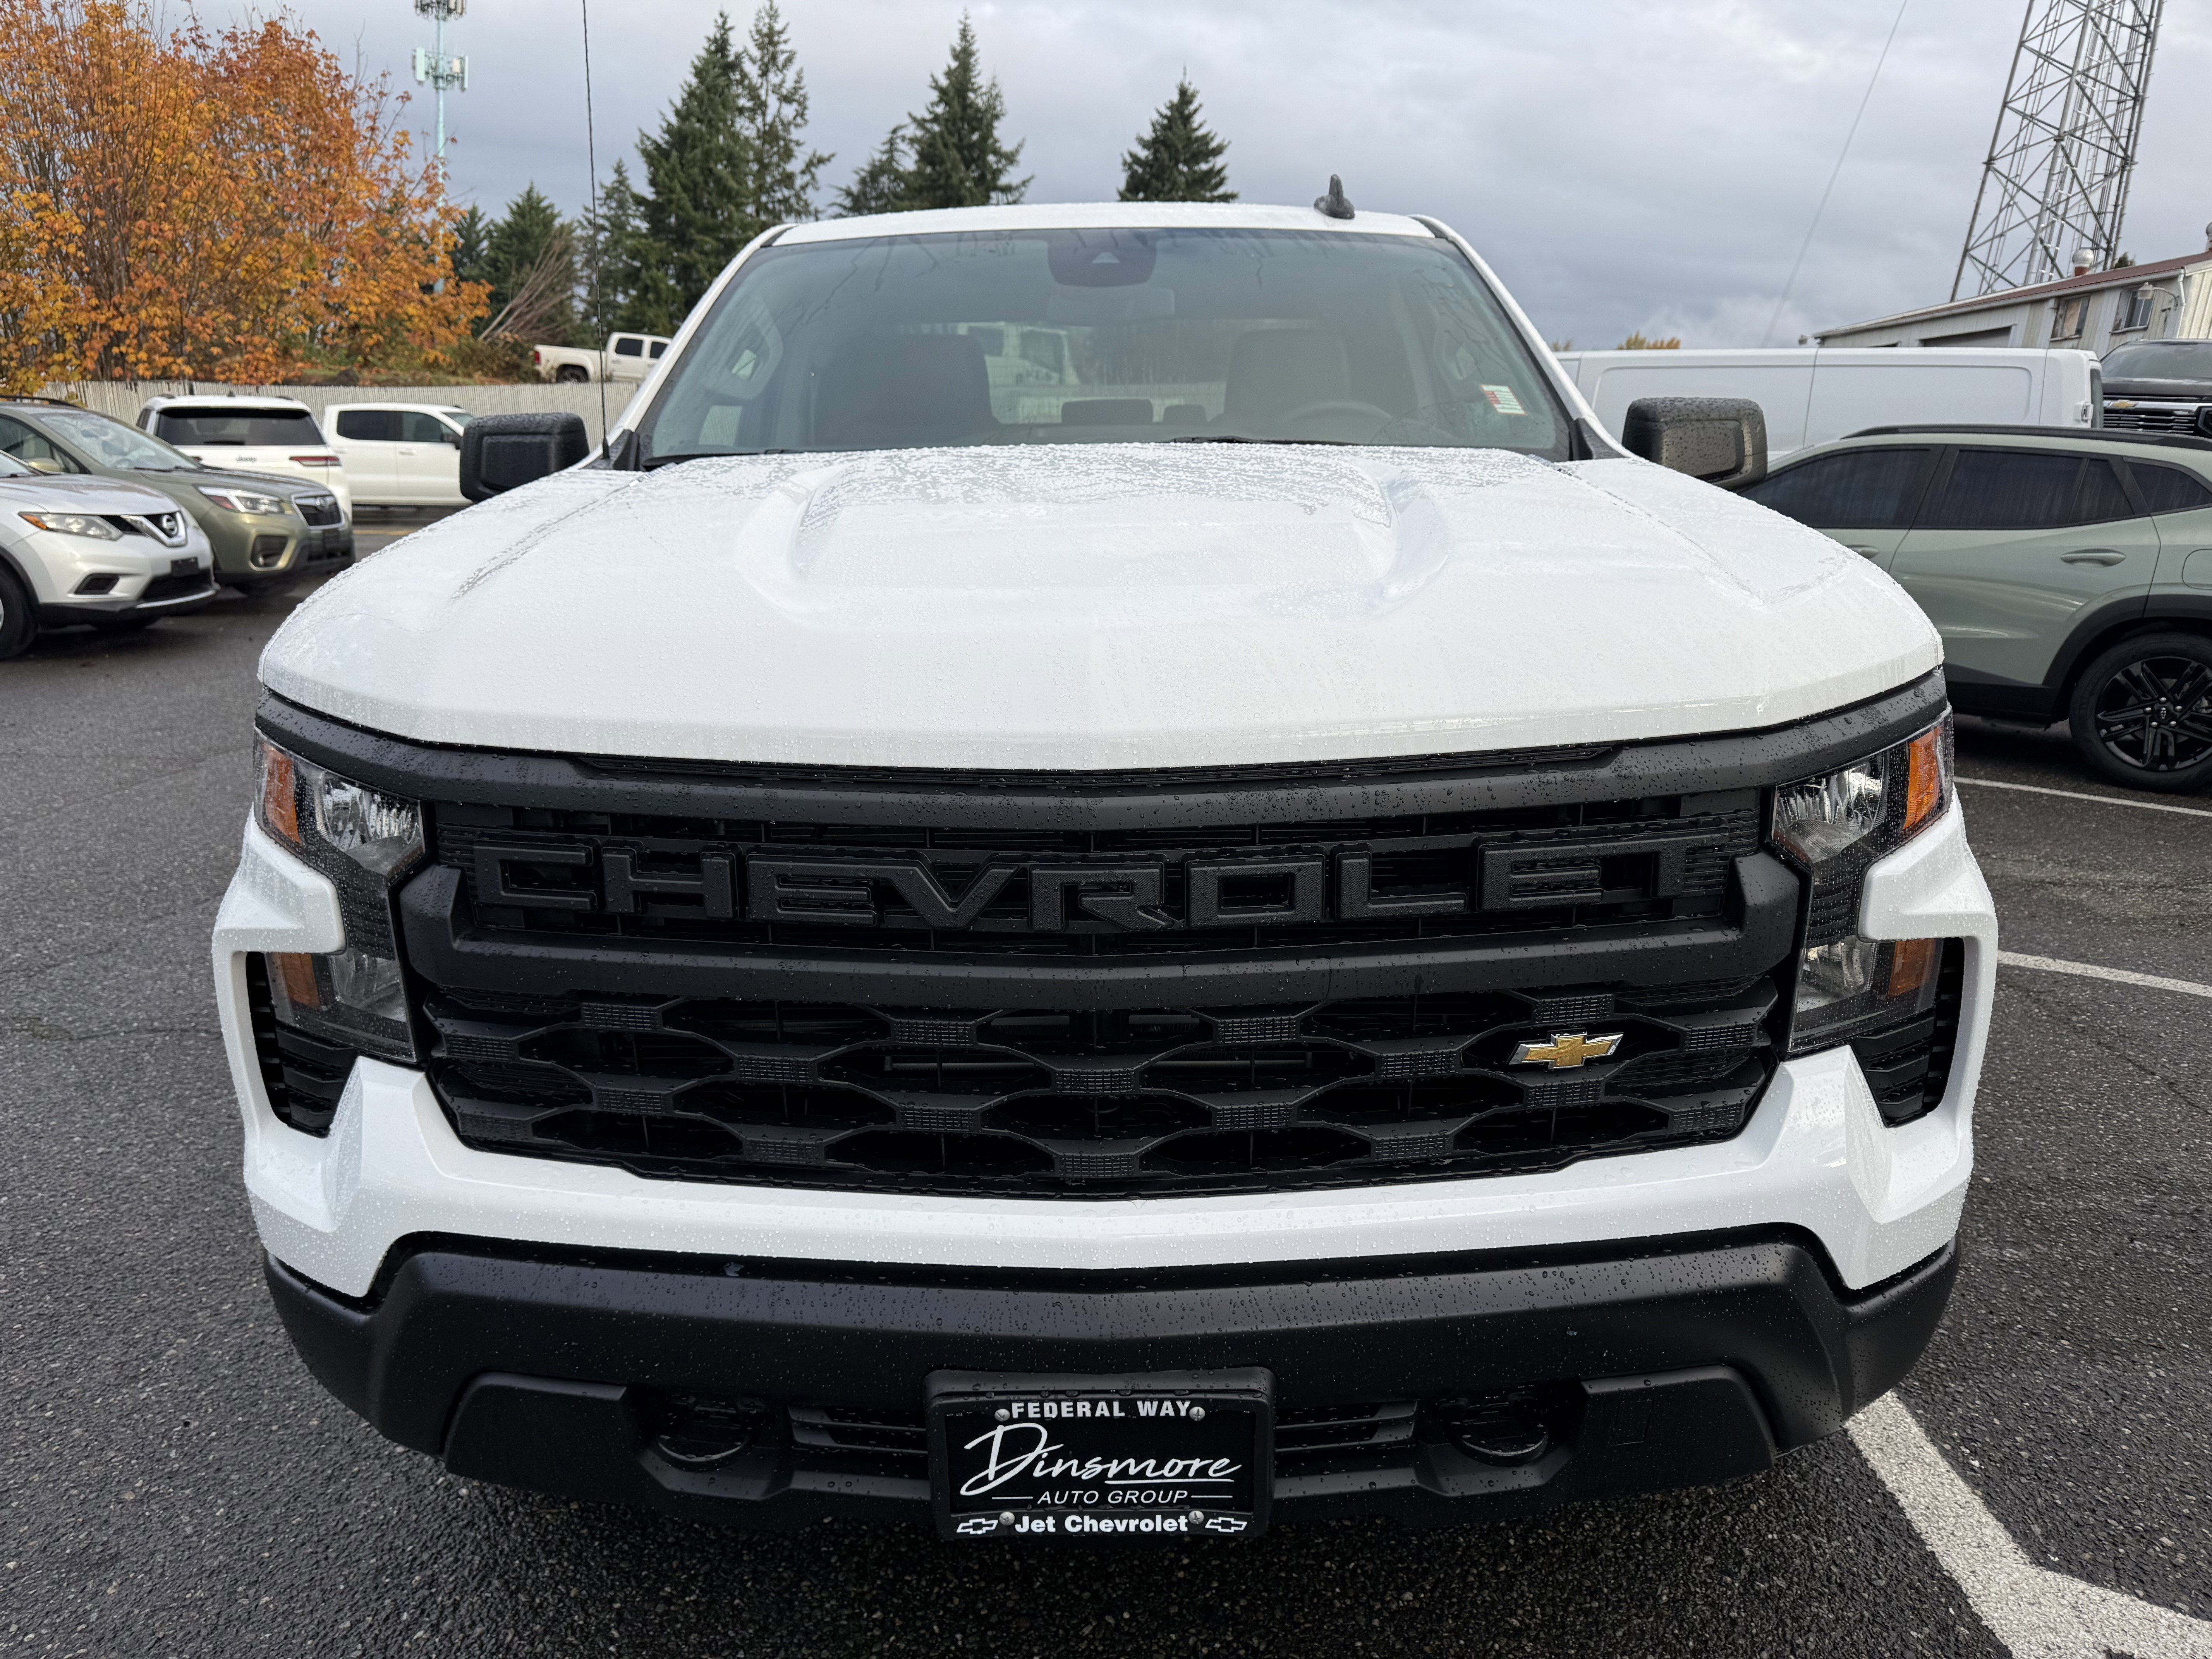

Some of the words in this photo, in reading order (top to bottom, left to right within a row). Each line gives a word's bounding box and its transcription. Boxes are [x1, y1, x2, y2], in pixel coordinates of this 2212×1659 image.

[474, 831, 1729, 930] CHEVROLET
[1012, 1401, 1125, 1418] FEDERAL
[1137, 1400, 1191, 1417] WAY
[960, 1423, 1242, 1496] Dinsmore
[1037, 1491, 1098, 1504] AUTO
[1108, 1491, 1188, 1504] GROUP
[1015, 1516, 1056, 1533] Jet
[1065, 1515, 1188, 1532] Chevrolet
